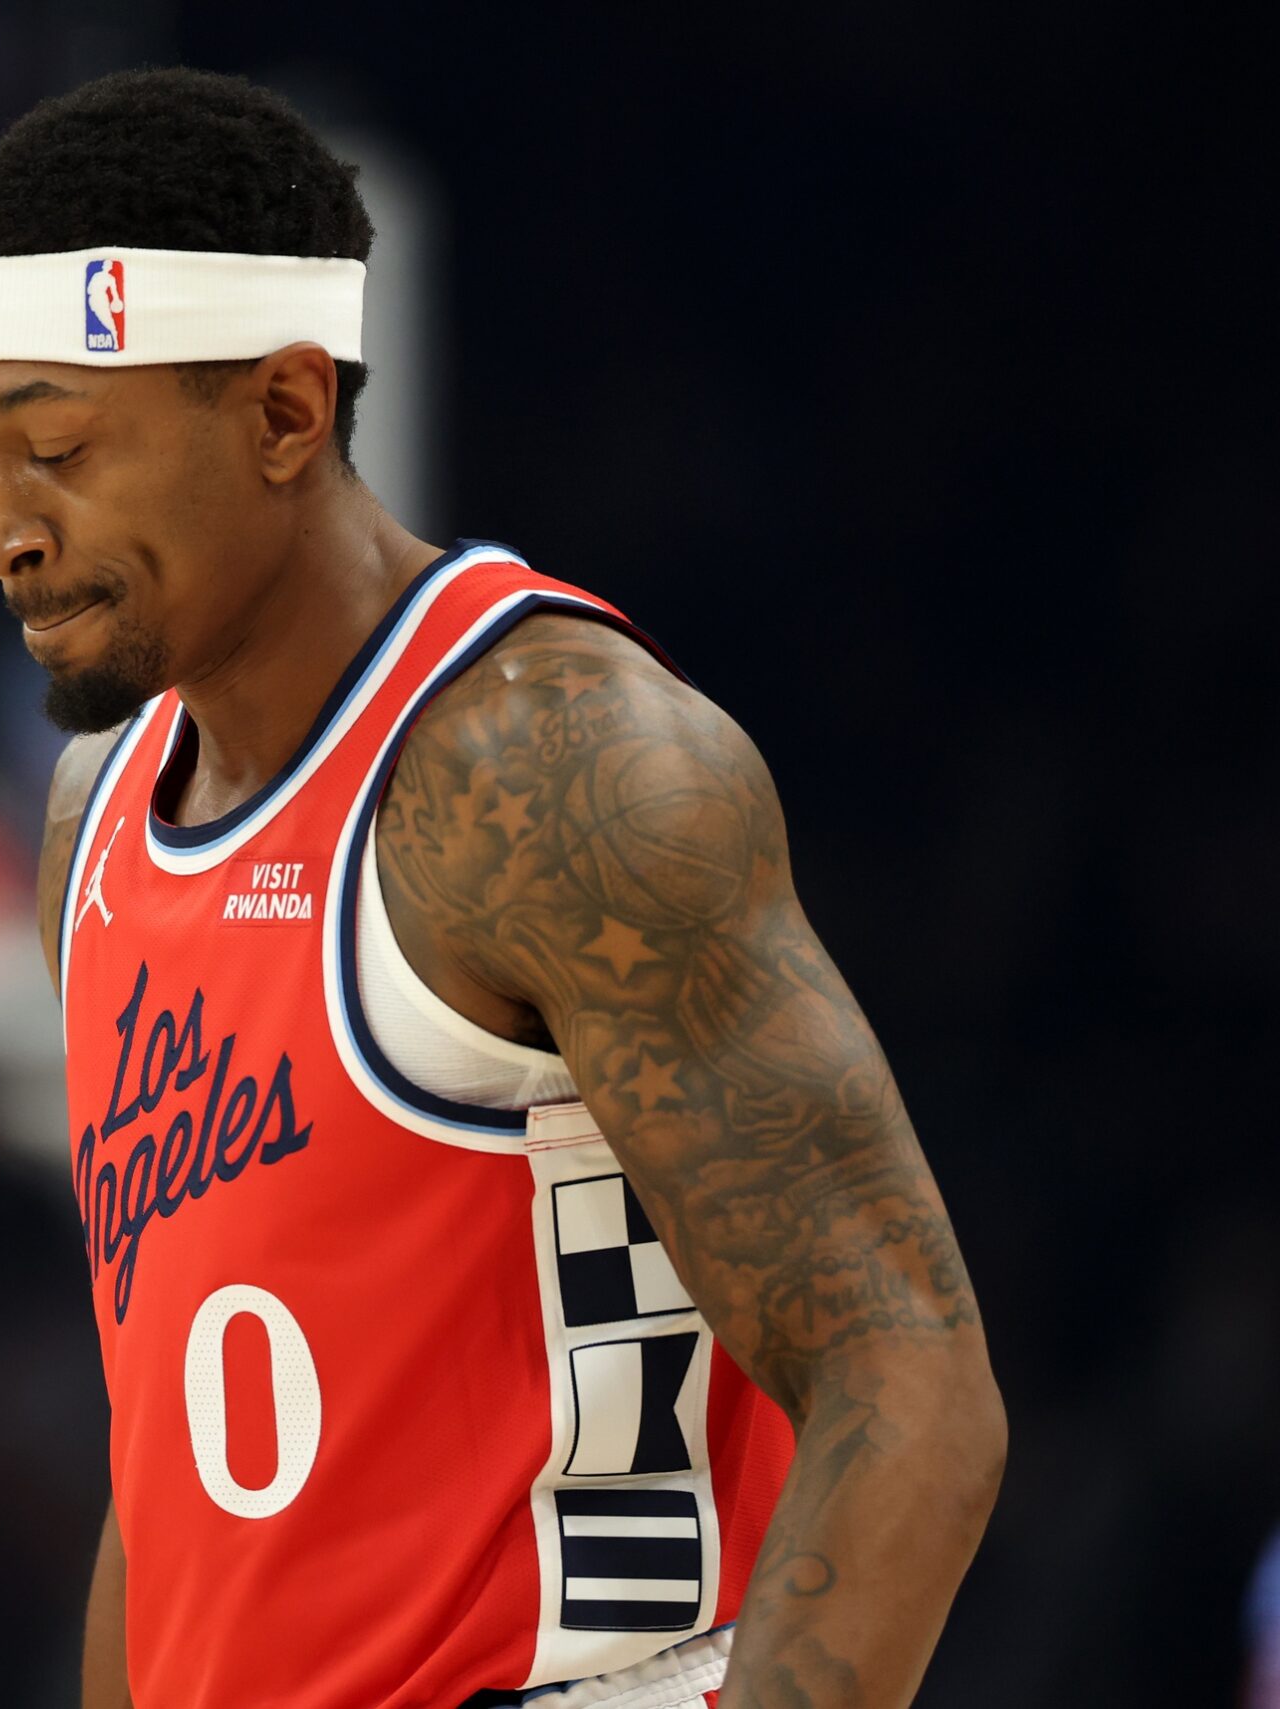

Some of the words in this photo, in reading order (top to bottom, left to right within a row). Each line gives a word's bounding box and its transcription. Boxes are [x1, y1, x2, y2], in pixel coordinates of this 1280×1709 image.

[88, 333, 113, 349] NBA
[251, 863, 303, 889] VISIT
[223, 893, 312, 919] RWANDA
[101, 960, 211, 1144] Los
[184, 1284, 322, 1519] 0
